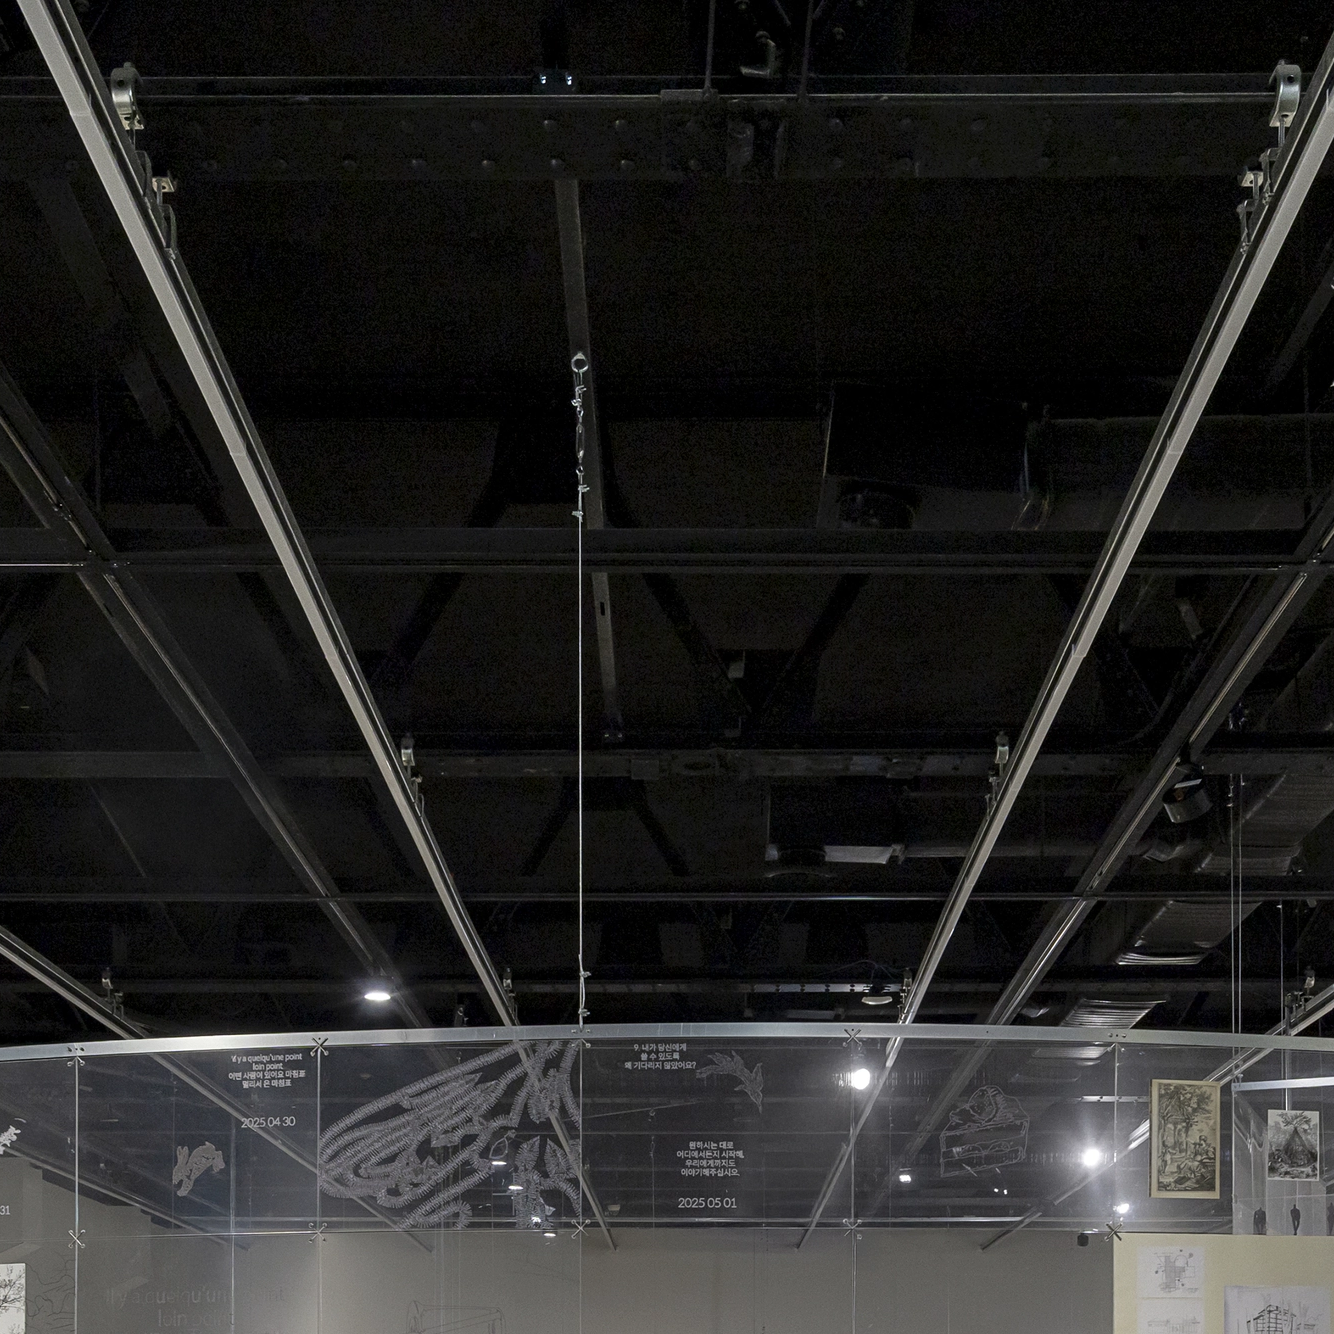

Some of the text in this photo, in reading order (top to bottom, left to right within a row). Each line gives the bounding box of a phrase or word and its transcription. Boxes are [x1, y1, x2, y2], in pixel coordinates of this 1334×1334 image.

[266, 1063, 283, 1071] point
[241, 1116, 296, 1128] 2025 04 30
[689, 1141, 734, 1149] 원하시는 대로
[677, 1150, 719, 1158] 어디에서든지
[678, 1198, 737, 1208] 2025 05 01
[0, 1205, 10, 1215] 31
